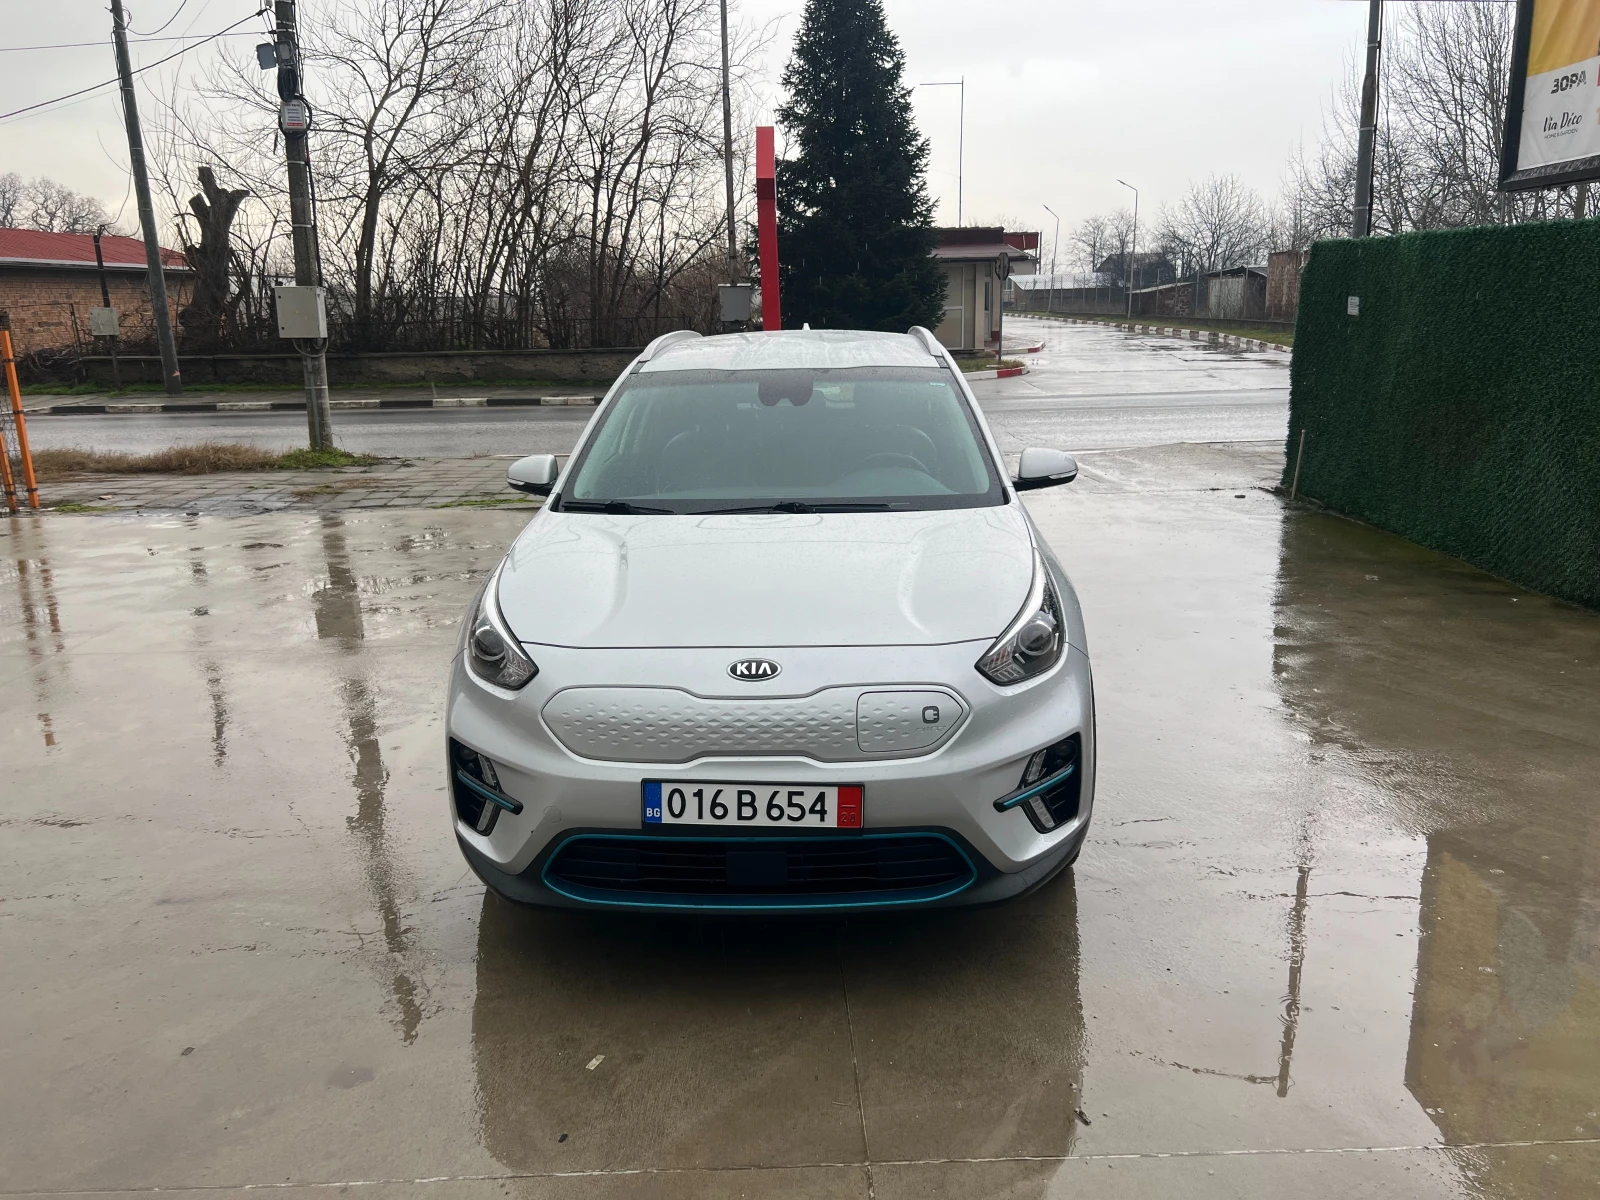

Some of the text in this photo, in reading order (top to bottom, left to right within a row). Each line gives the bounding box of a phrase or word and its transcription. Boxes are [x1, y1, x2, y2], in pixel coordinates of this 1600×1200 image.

[736, 661, 772, 675] KIA
[646, 807, 661, 818] BG
[841, 811, 857, 824] 28
